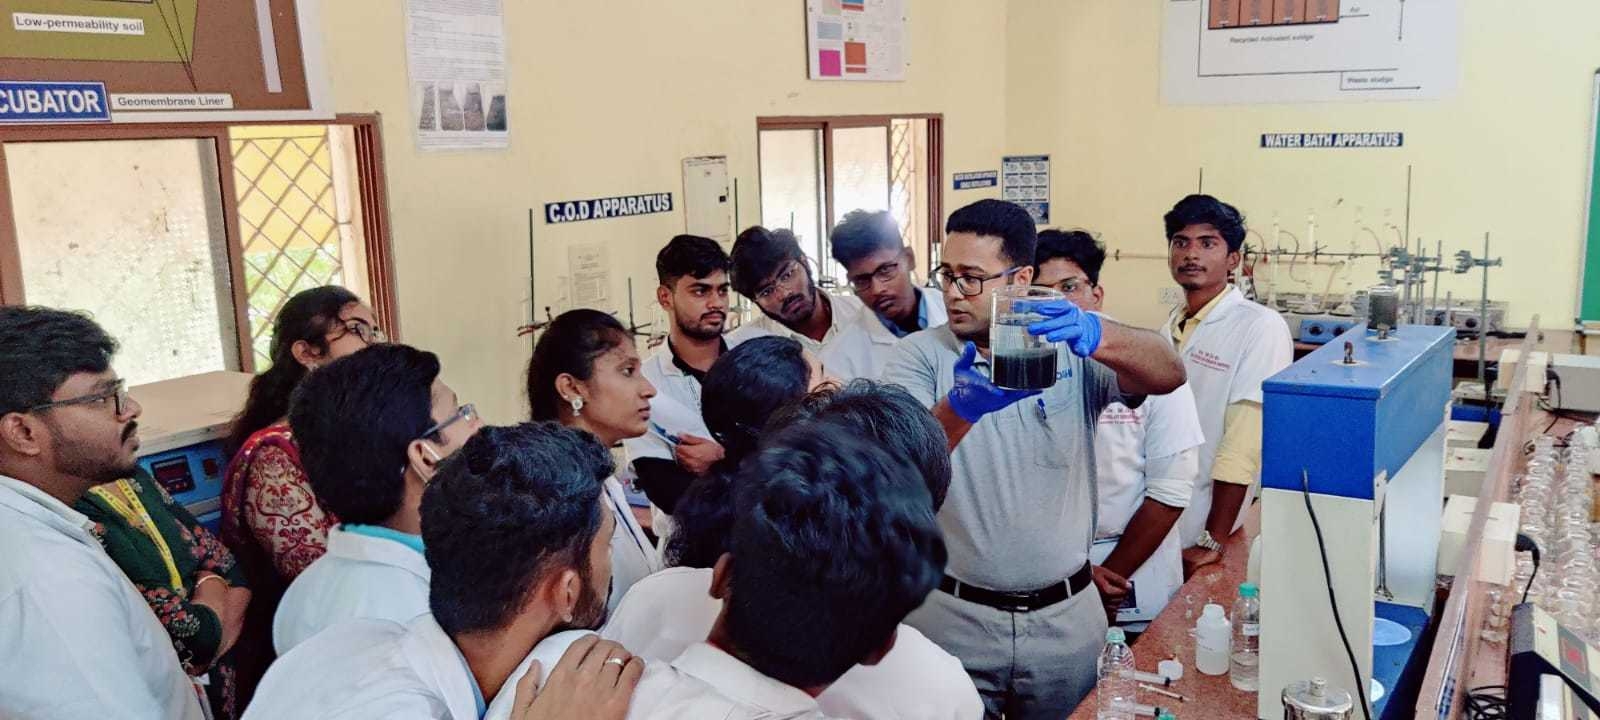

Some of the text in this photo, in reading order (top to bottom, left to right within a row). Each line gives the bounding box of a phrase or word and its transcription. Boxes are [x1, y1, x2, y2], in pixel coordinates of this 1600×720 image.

[15, 15, 143, 32] Low-permeability soil
[117, 95, 225, 106] Geomembrane Liner
[1264, 132, 1400, 147] WATER BATH APPARATUS
[549, 193, 671, 222] C.O.D APPARATUS
